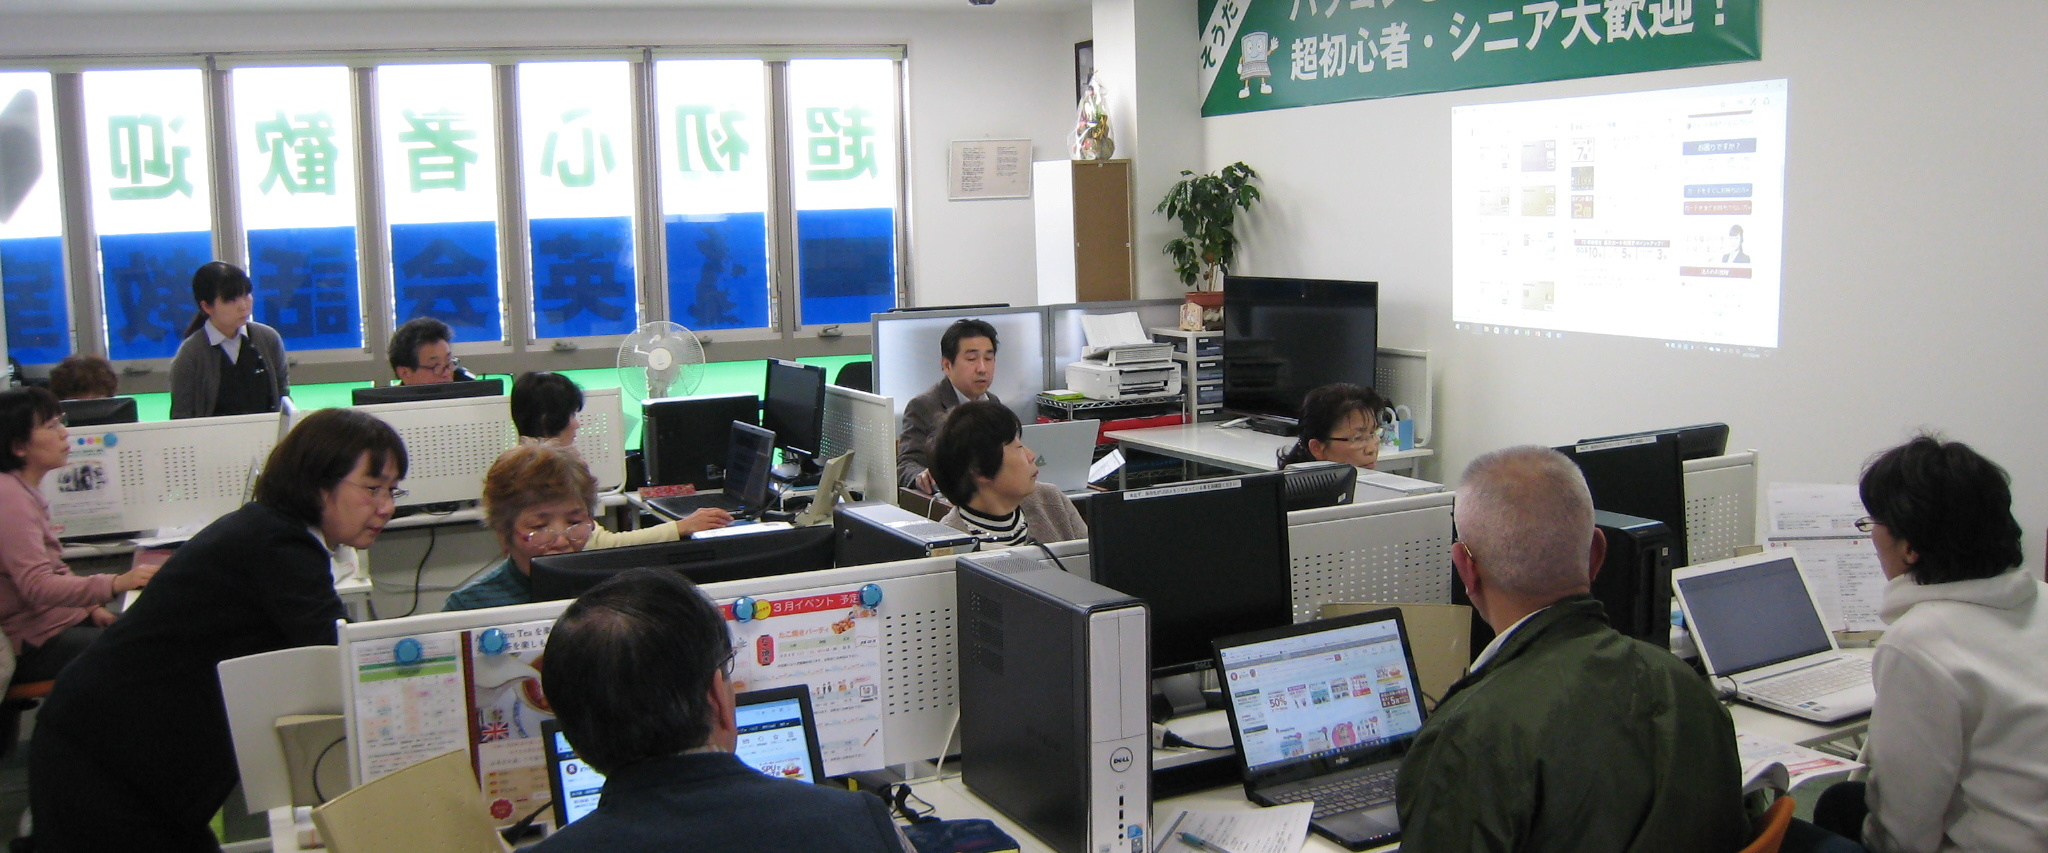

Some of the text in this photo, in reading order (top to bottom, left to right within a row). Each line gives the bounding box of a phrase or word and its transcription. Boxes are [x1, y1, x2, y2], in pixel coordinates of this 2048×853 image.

[517, 629, 533, 638] Tea
[1269, 697, 1287, 708] 50%
[1113, 756, 1130, 764] DELL
